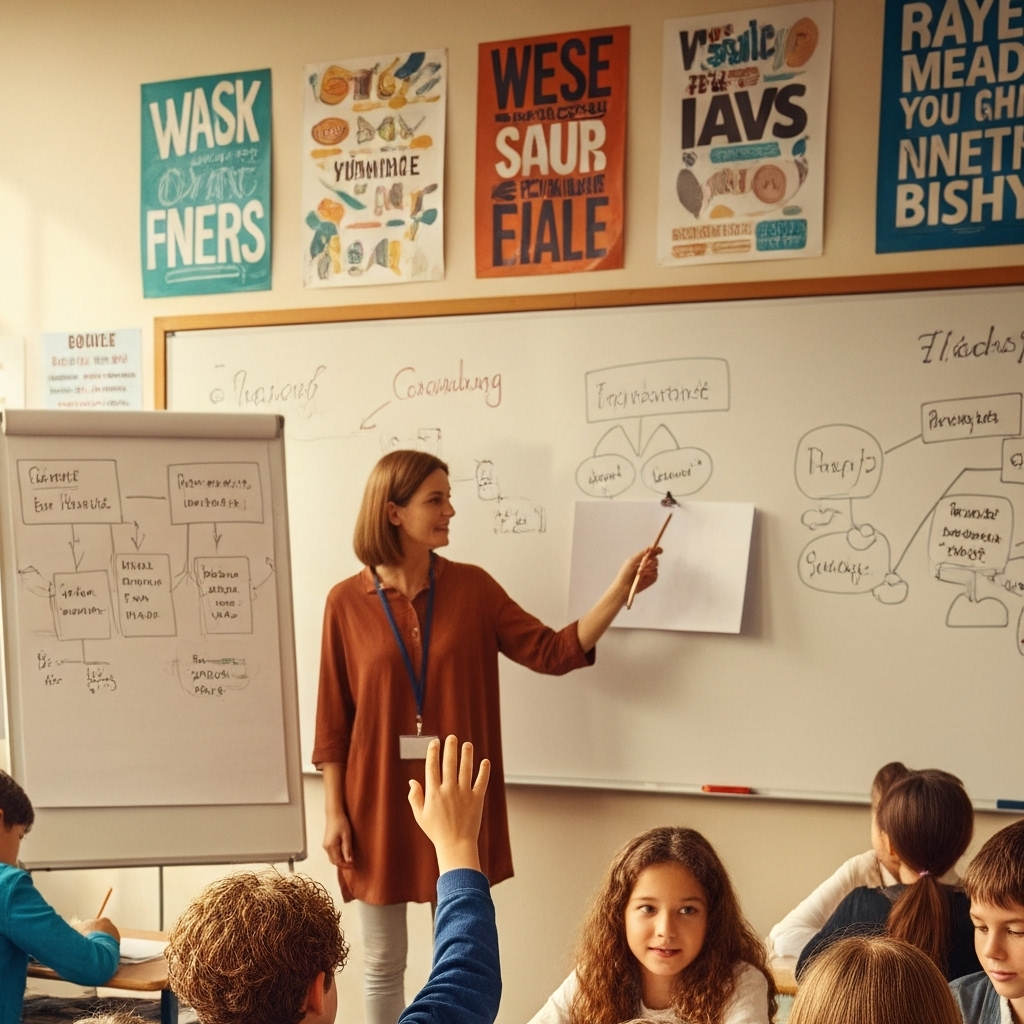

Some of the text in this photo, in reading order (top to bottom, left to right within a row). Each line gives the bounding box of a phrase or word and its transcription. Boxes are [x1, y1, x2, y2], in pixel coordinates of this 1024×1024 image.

[491, 34, 614, 110] WESE
[149, 79, 262, 160] WASK
[899, 92, 961, 130] YOU
[495, 119, 607, 178] SAUR
[147, 199, 266, 270] FNERS
